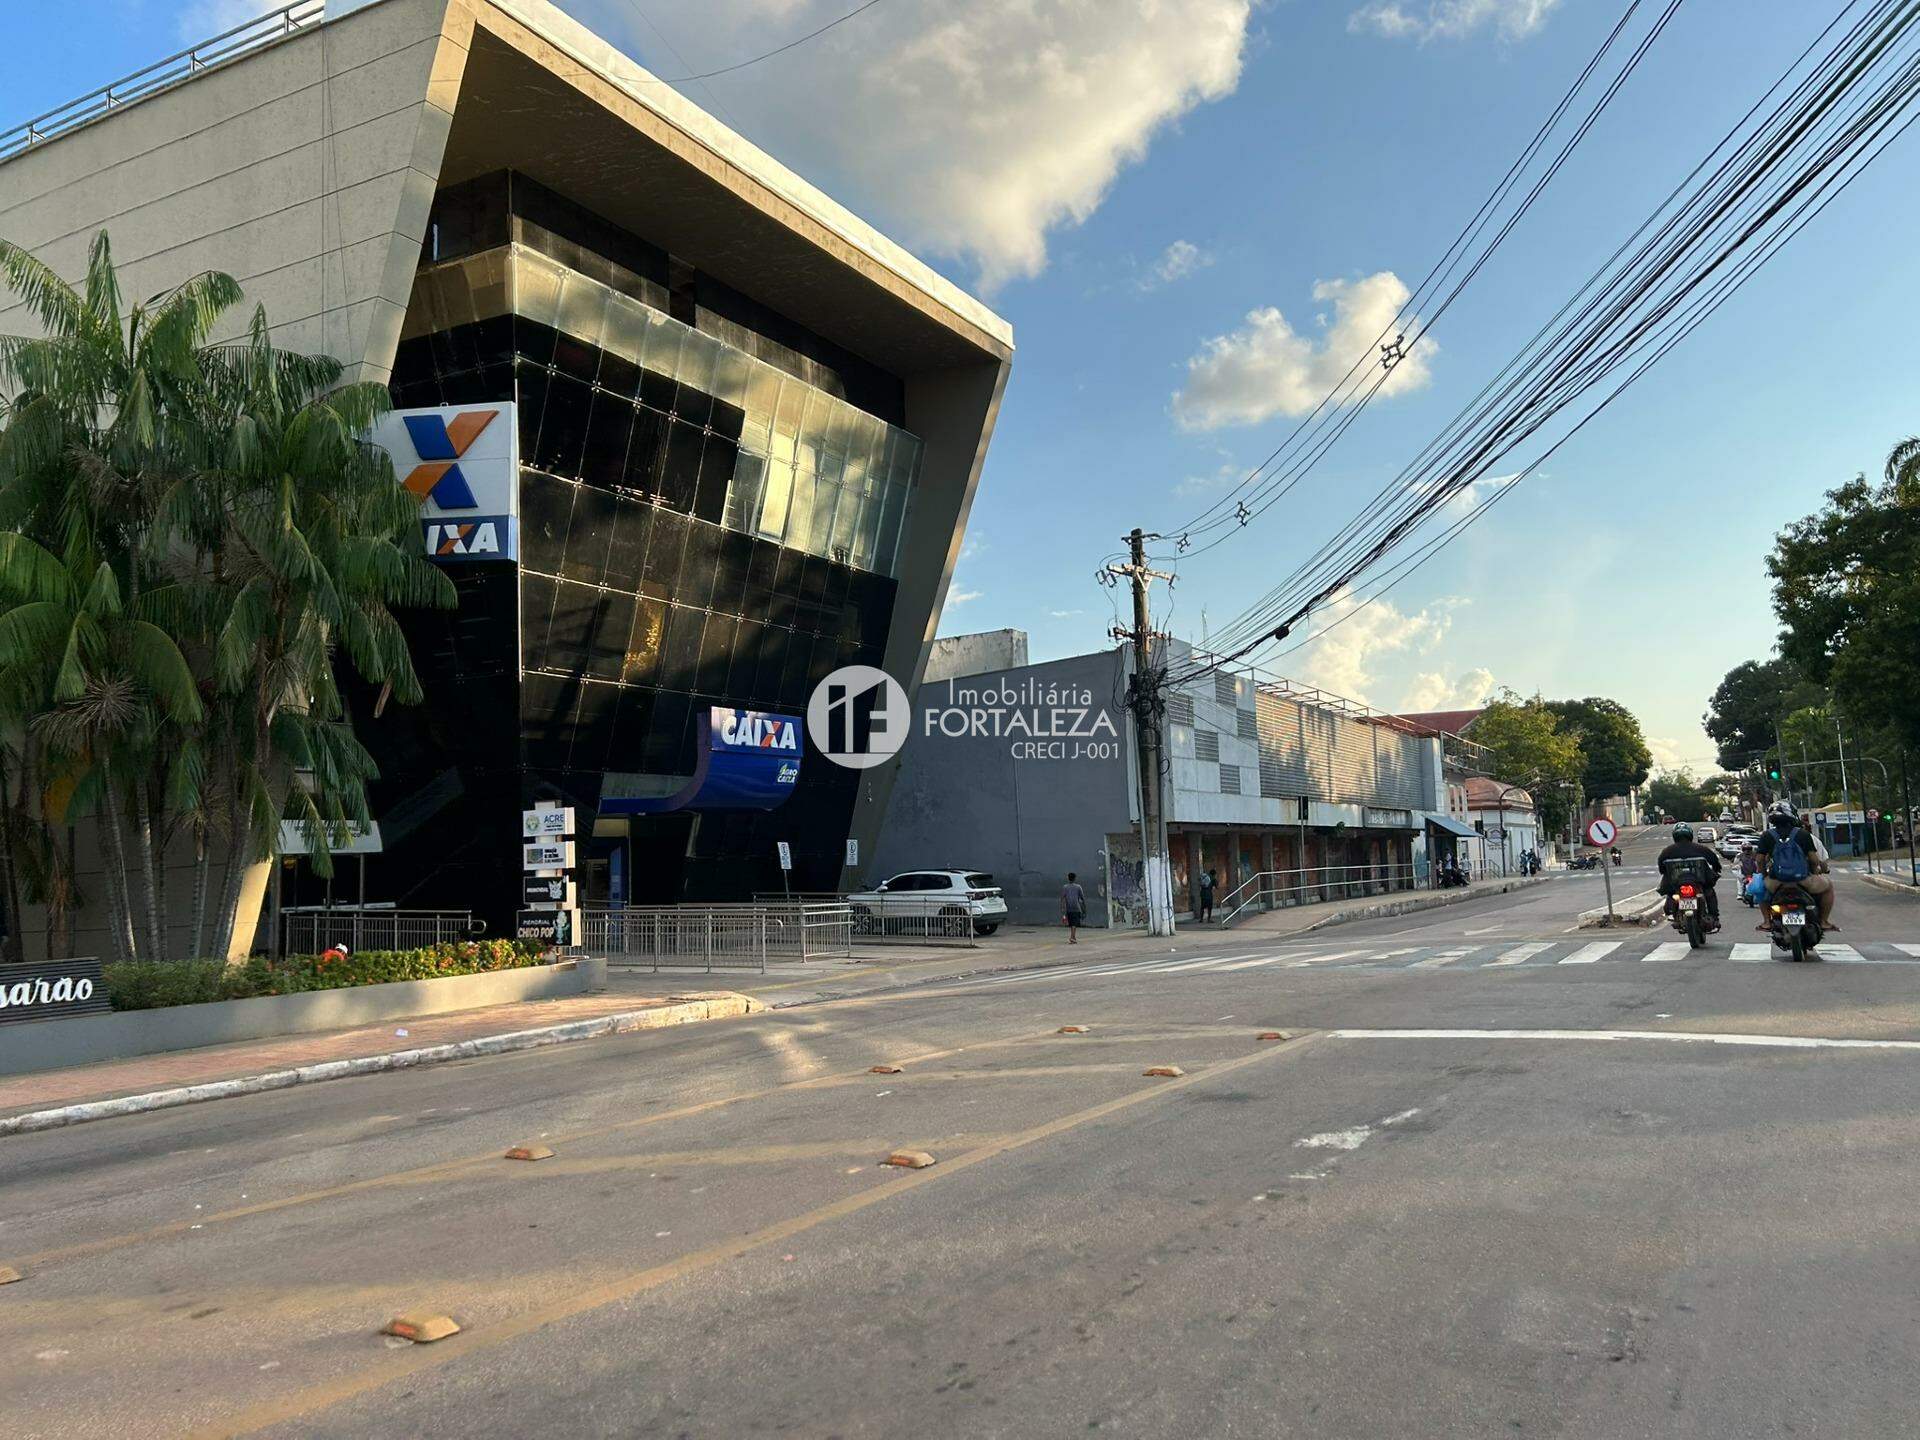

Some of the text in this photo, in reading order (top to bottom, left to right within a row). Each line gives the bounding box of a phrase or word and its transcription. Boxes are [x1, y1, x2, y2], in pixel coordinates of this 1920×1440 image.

[721, 715, 797, 750] CAIXA
[544, 814, 564, 824] ACRE
[518, 926, 555, 939] CHICO POP
